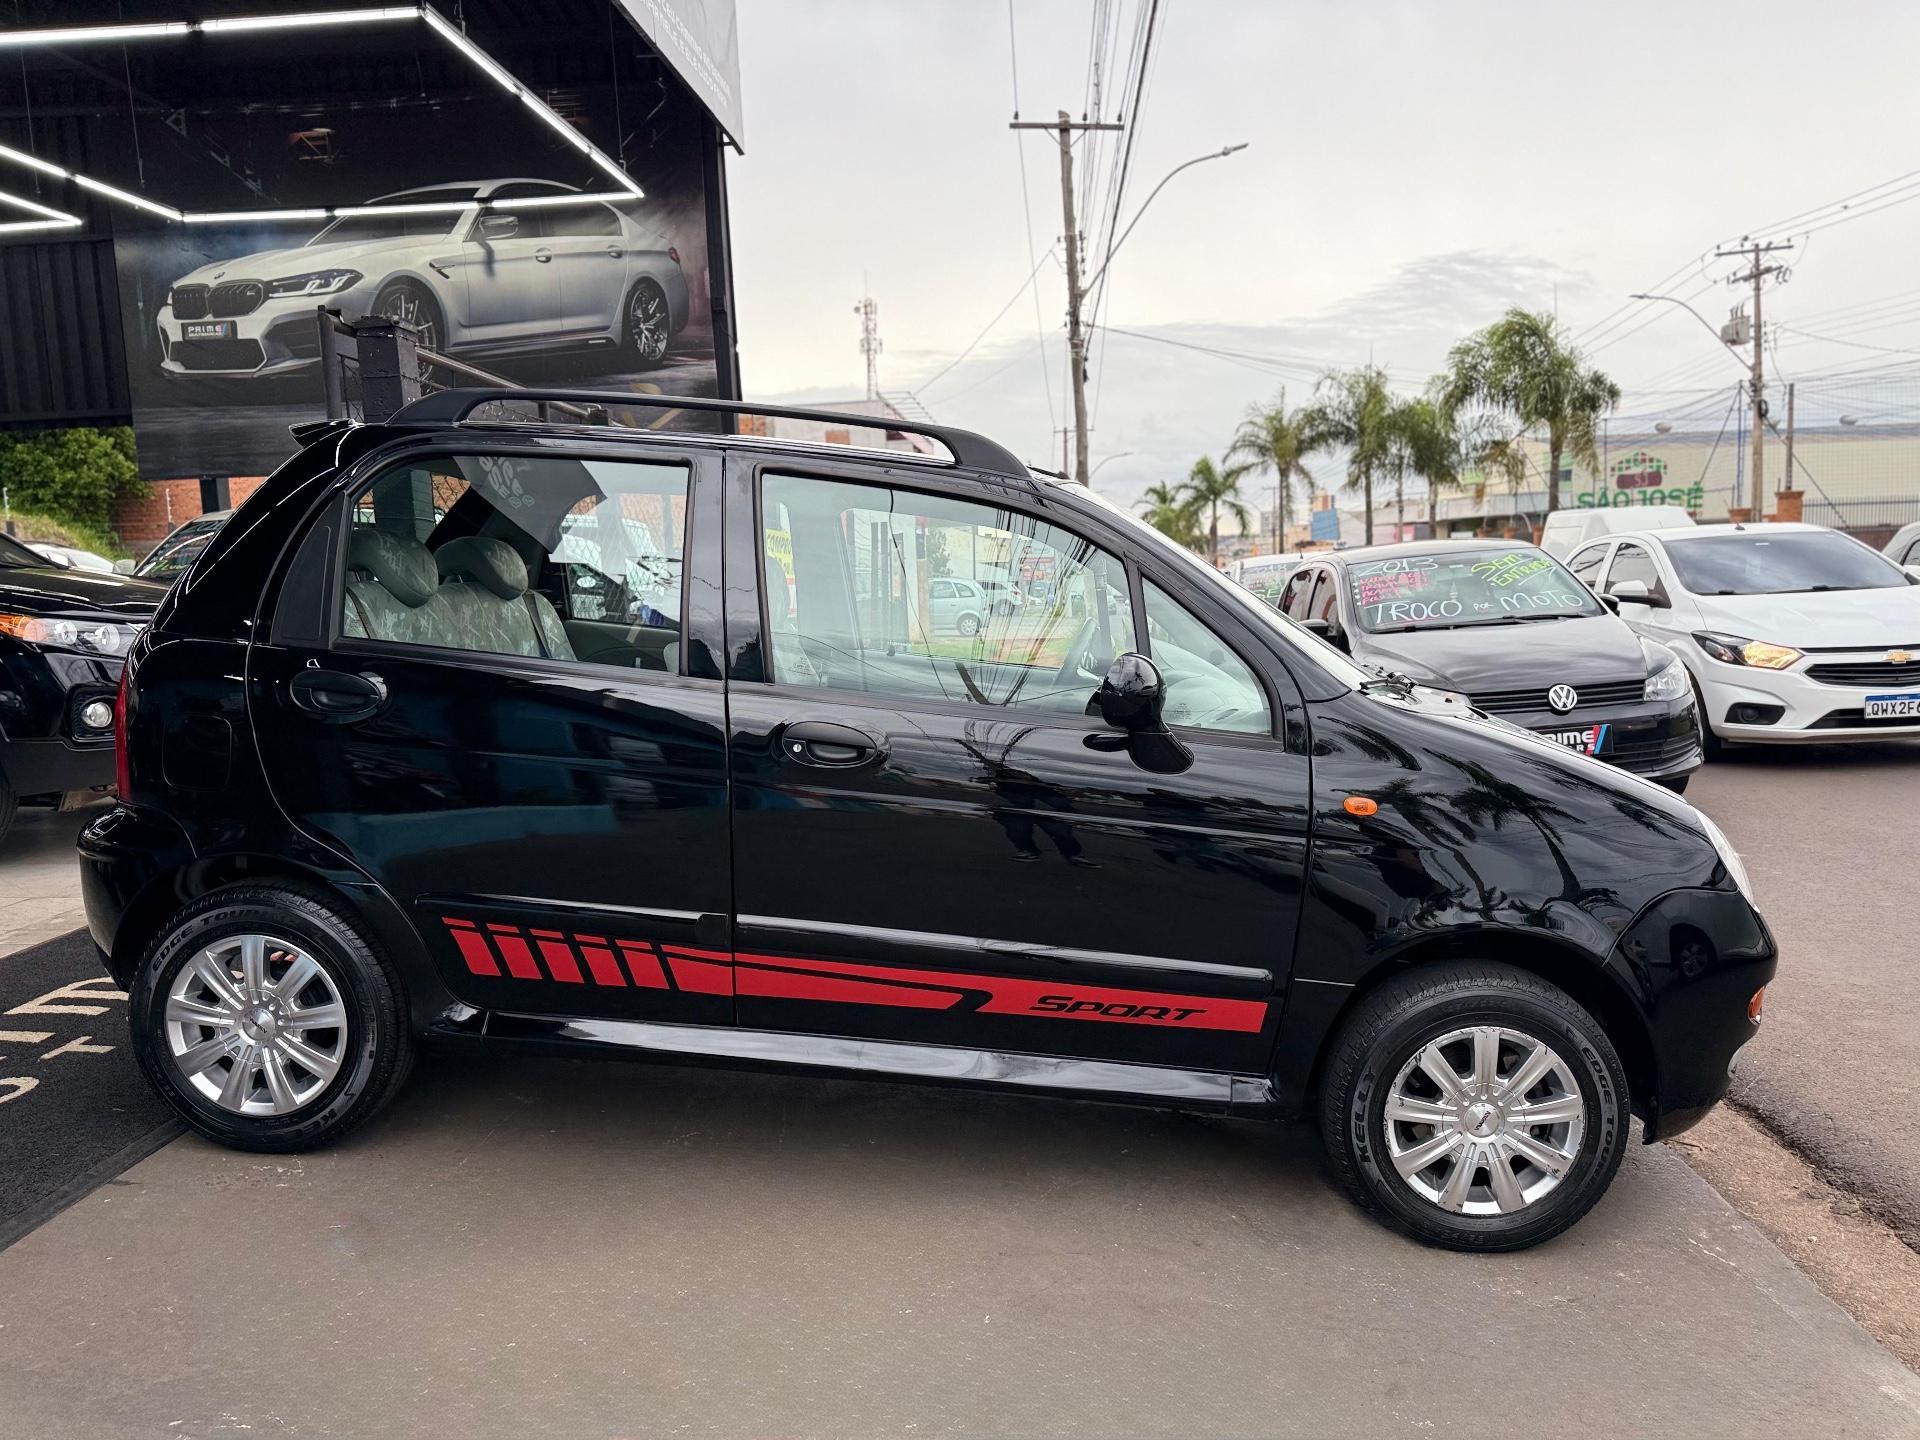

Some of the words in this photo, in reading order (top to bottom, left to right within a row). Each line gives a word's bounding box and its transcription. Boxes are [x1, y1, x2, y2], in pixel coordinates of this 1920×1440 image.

[188, 325, 222, 333] PRIME
[1359, 557, 1438, 577] 2013
[1364, 600, 1462, 624] TROCO
[1500, 590, 1583, 611] MOTO
[152, 924, 195, 972] EDGE
[1029, 995, 1208, 1021] SPORT
[1581, 1046, 1614, 1105] EDGE
[1354, 1065, 1376, 1163] KELLY
